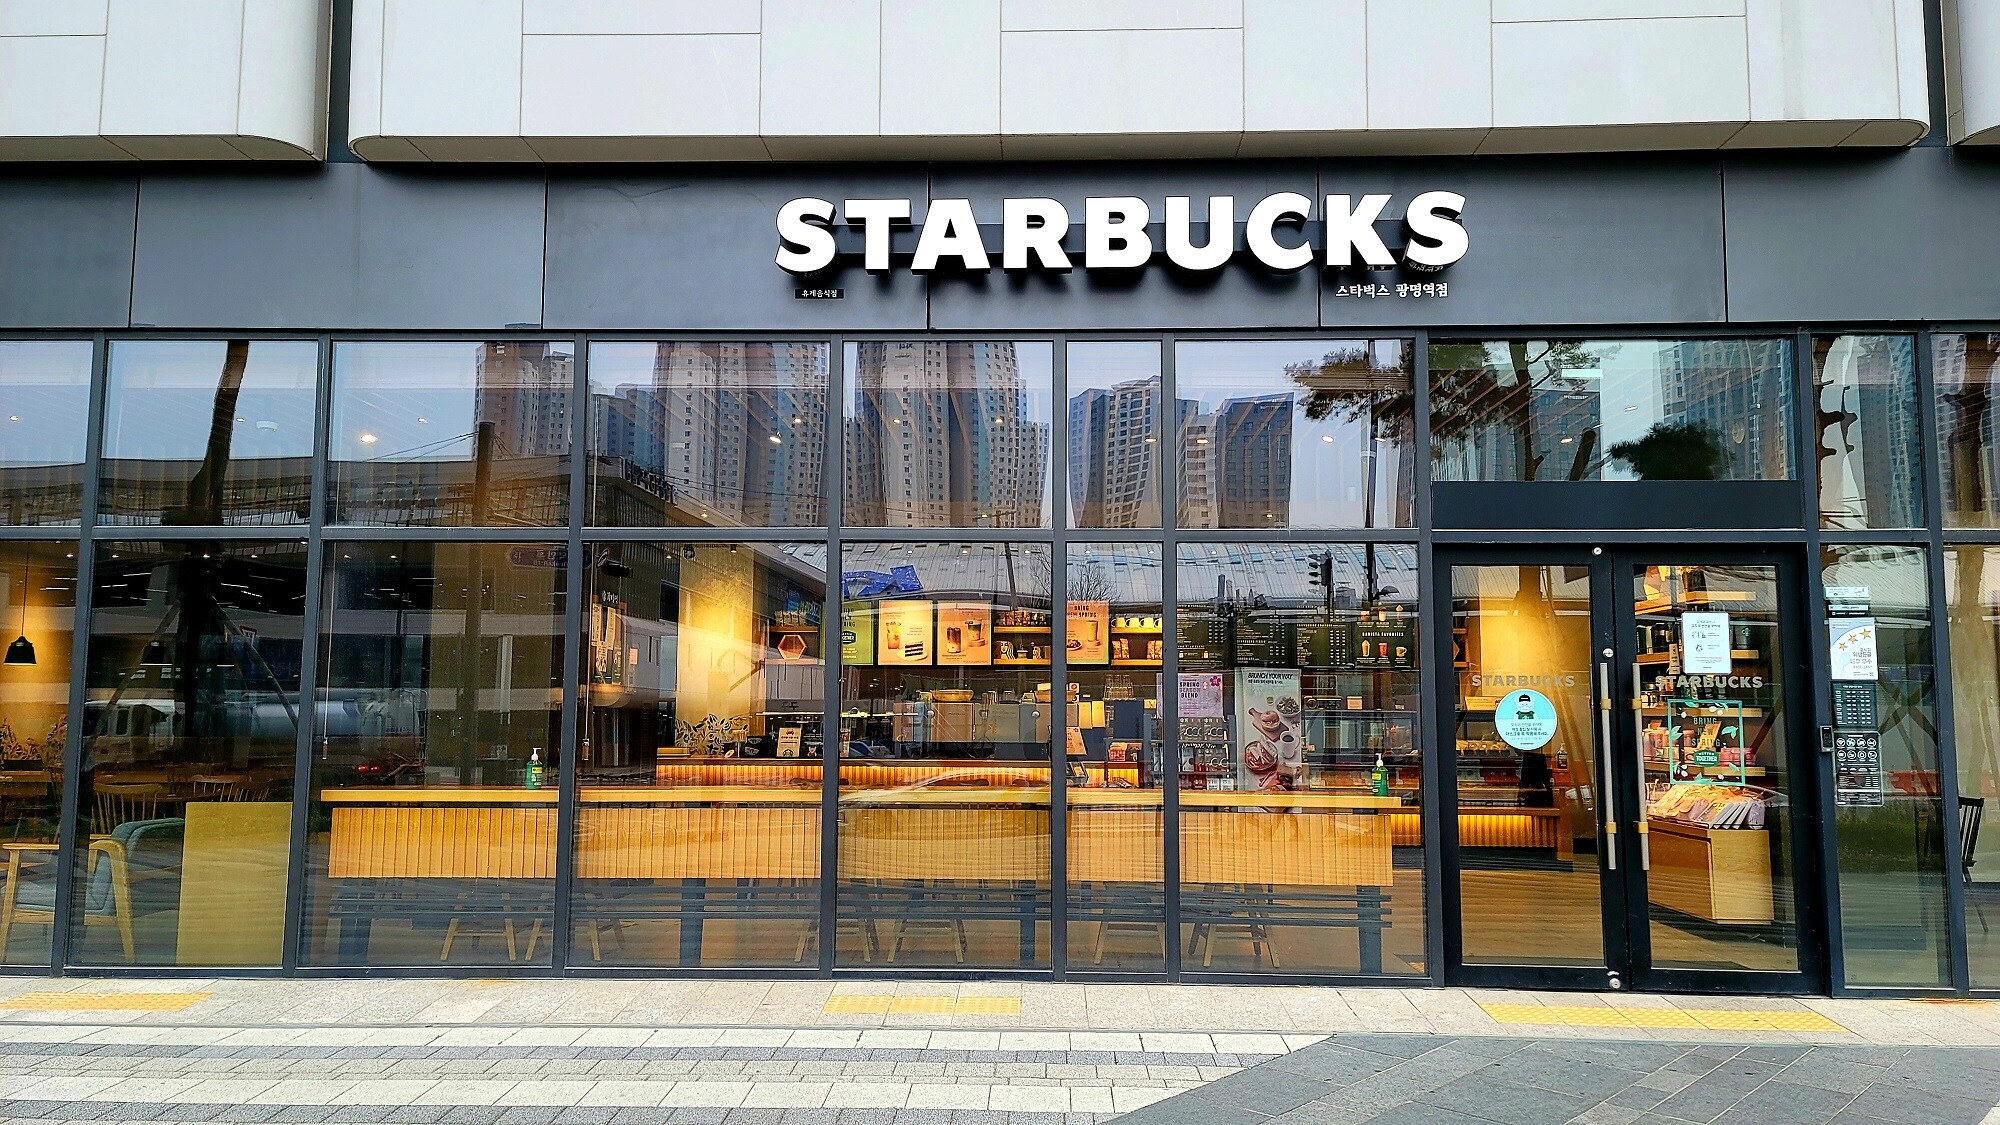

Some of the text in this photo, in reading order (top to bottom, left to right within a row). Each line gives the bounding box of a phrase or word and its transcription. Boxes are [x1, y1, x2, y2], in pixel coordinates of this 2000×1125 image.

[775, 191, 1470, 273] STARBUCKS
[1335, 282, 1449, 299] 스타벅스 광명역점
[1471, 674, 1575, 687] STARBUCKS
[1655, 676, 1763, 689] STARBUCKS
[1693, 717, 1718, 726] BRING
[1697, 728, 1714, 736] NEW
[1691, 738, 1721, 747] SPRING
